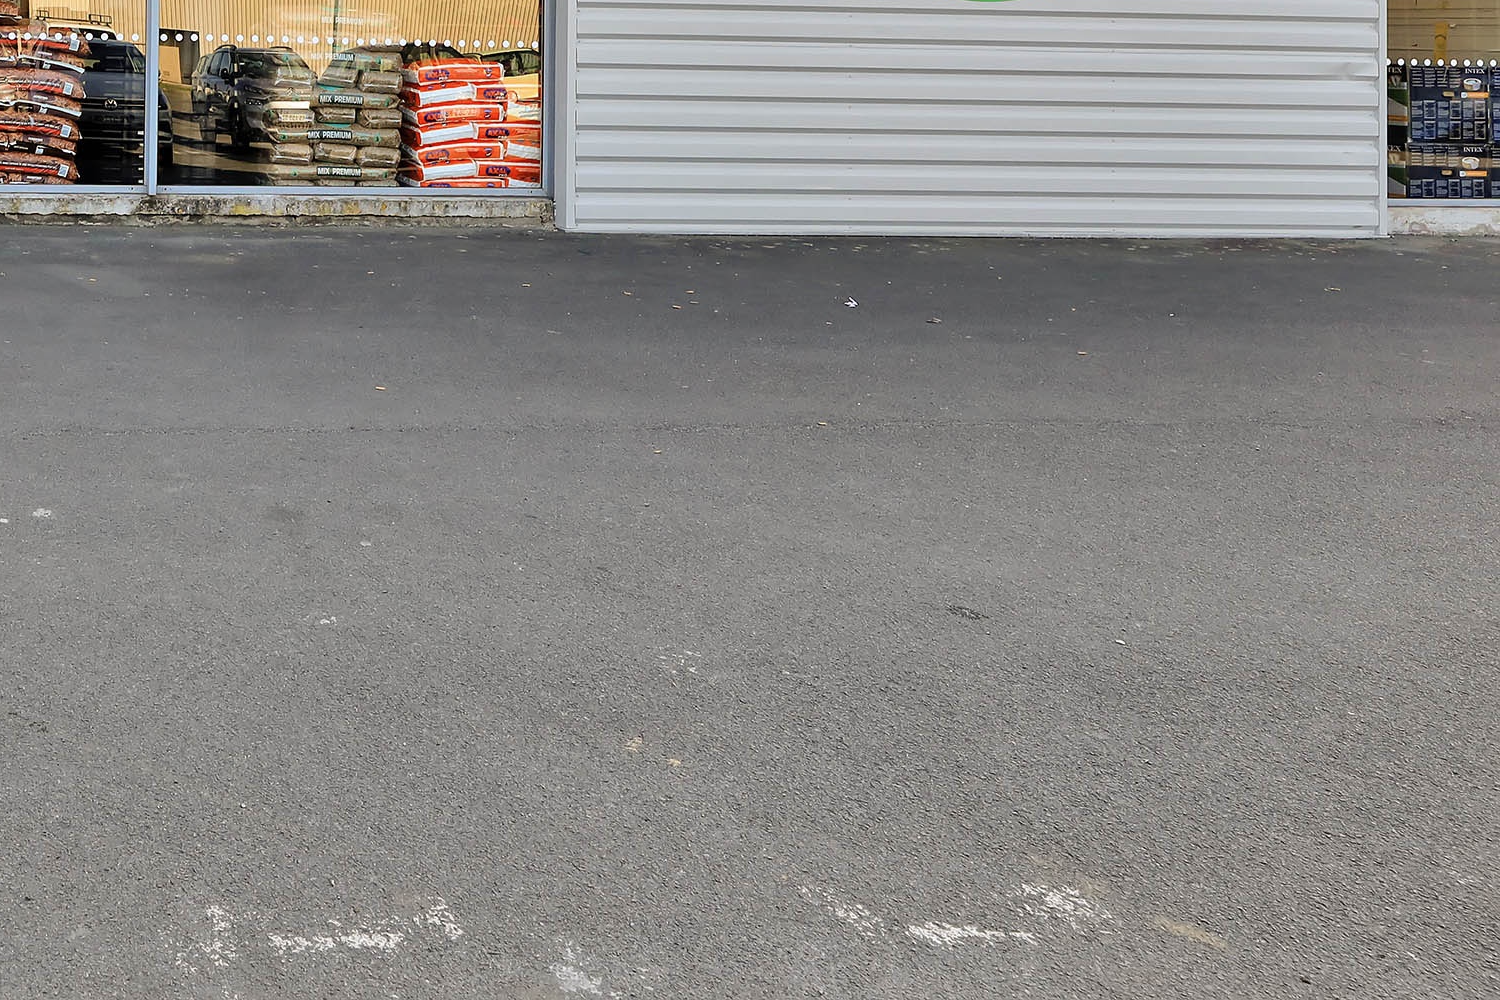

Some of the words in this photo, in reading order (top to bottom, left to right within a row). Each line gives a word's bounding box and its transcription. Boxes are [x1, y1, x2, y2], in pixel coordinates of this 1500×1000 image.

[325, 53, 354, 61] PREMIUM
[319, 95, 332, 103] MIX
[334, 95, 363, 105] PREMIUM
[307, 130, 320, 139] MIX
[322, 131, 352, 140] PREMIUM
[317, 167, 330, 175] MIX
[332, 167, 361, 176] PREMIUM
